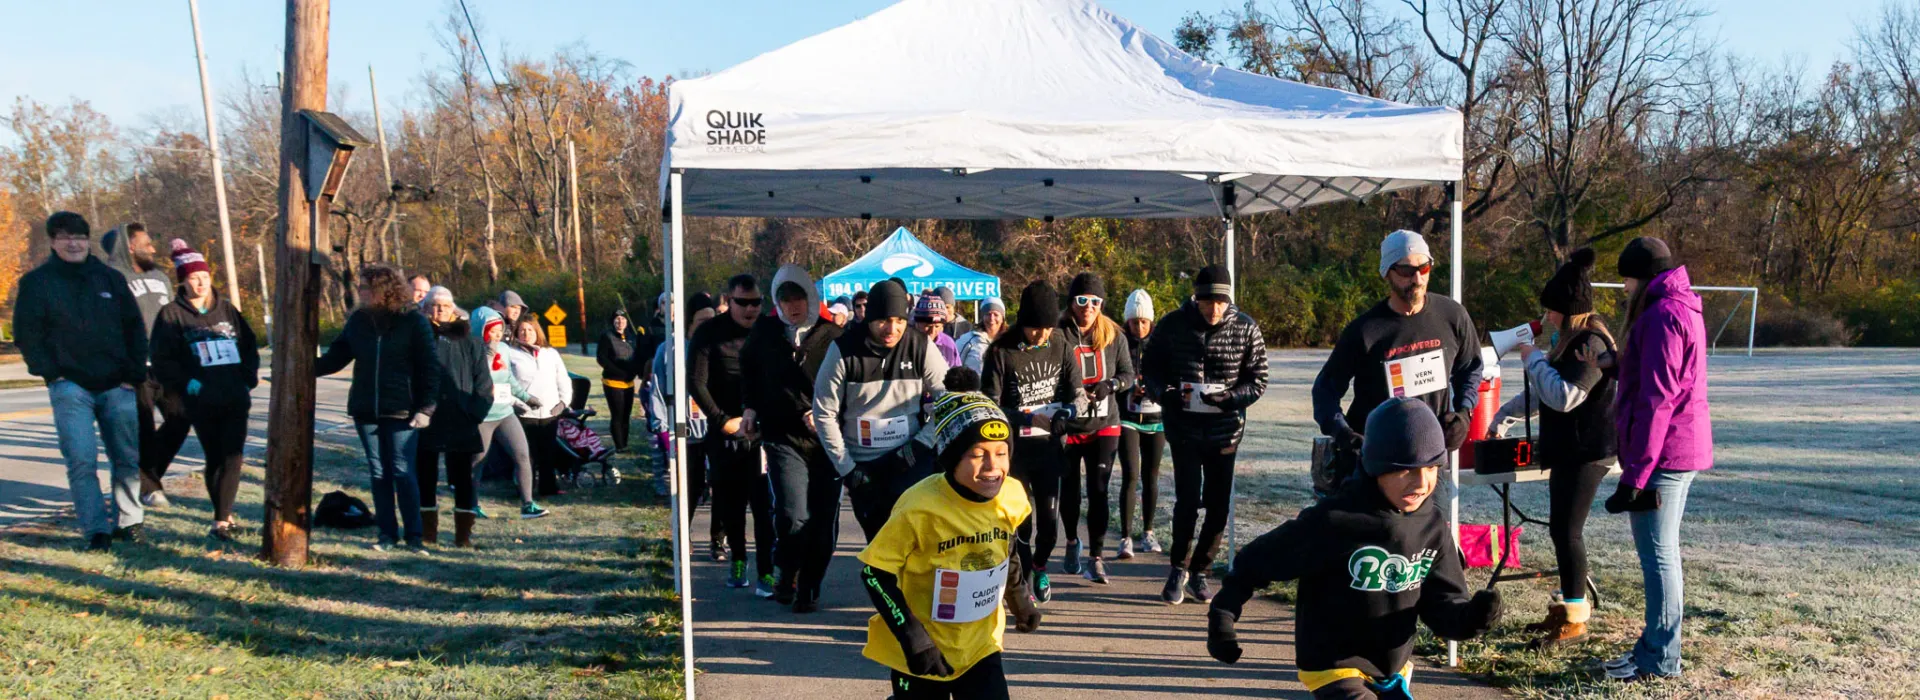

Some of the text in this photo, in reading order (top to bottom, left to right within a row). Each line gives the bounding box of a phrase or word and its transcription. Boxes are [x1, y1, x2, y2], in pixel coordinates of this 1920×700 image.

[706, 109, 764, 129] QUIK
[706, 129, 766, 145] SHADE
[1414, 377, 1435, 386] PAYNE
[1415, 370, 1432, 378] VERN
[1017, 377, 1056, 394] WE MOVE
[938, 531, 993, 554] Running
[972, 584, 999, 599] CAIDEN
[974, 595, 996, 609] NORD
